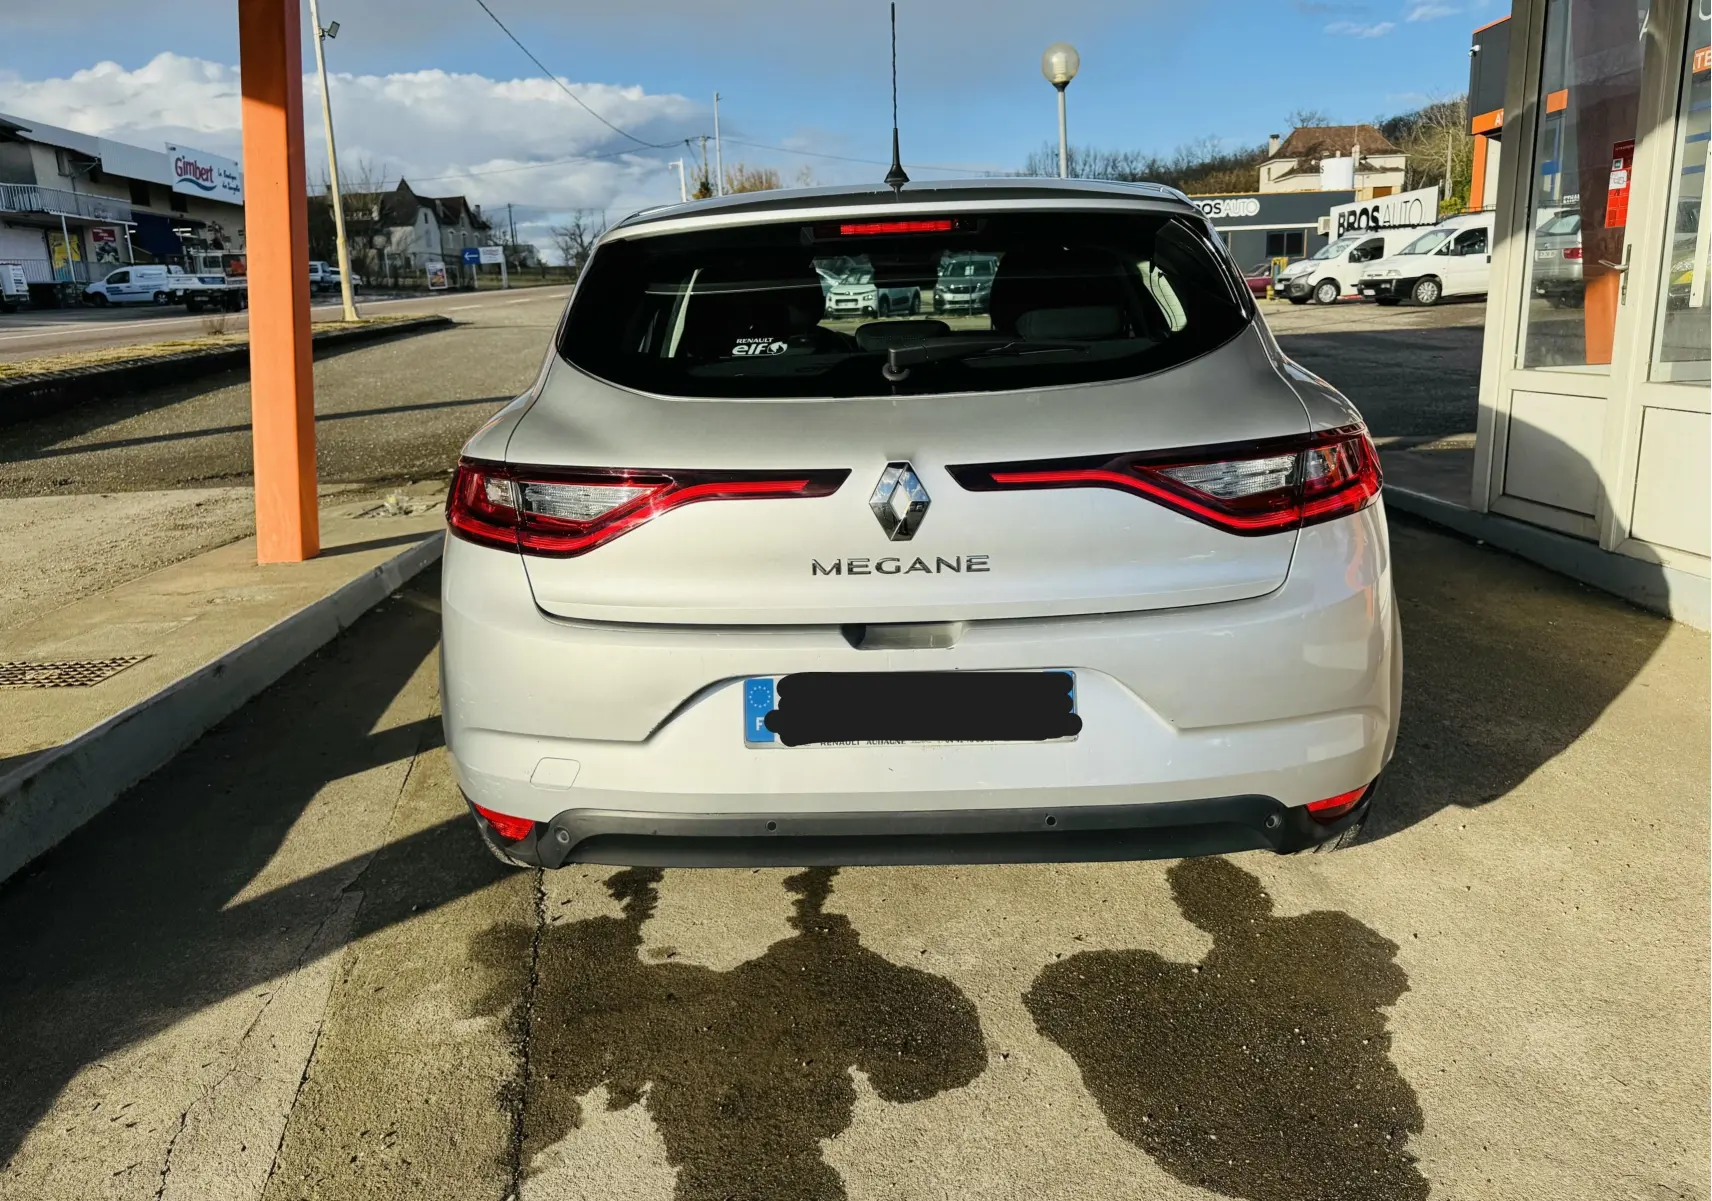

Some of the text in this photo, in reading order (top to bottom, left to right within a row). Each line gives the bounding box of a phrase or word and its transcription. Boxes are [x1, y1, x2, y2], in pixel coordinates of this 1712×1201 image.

[175, 155, 214, 184] Gimbert
[732, 343, 768, 355] elf
[811, 554, 991, 576] MEGANE
[756, 716, 766, 731] F
